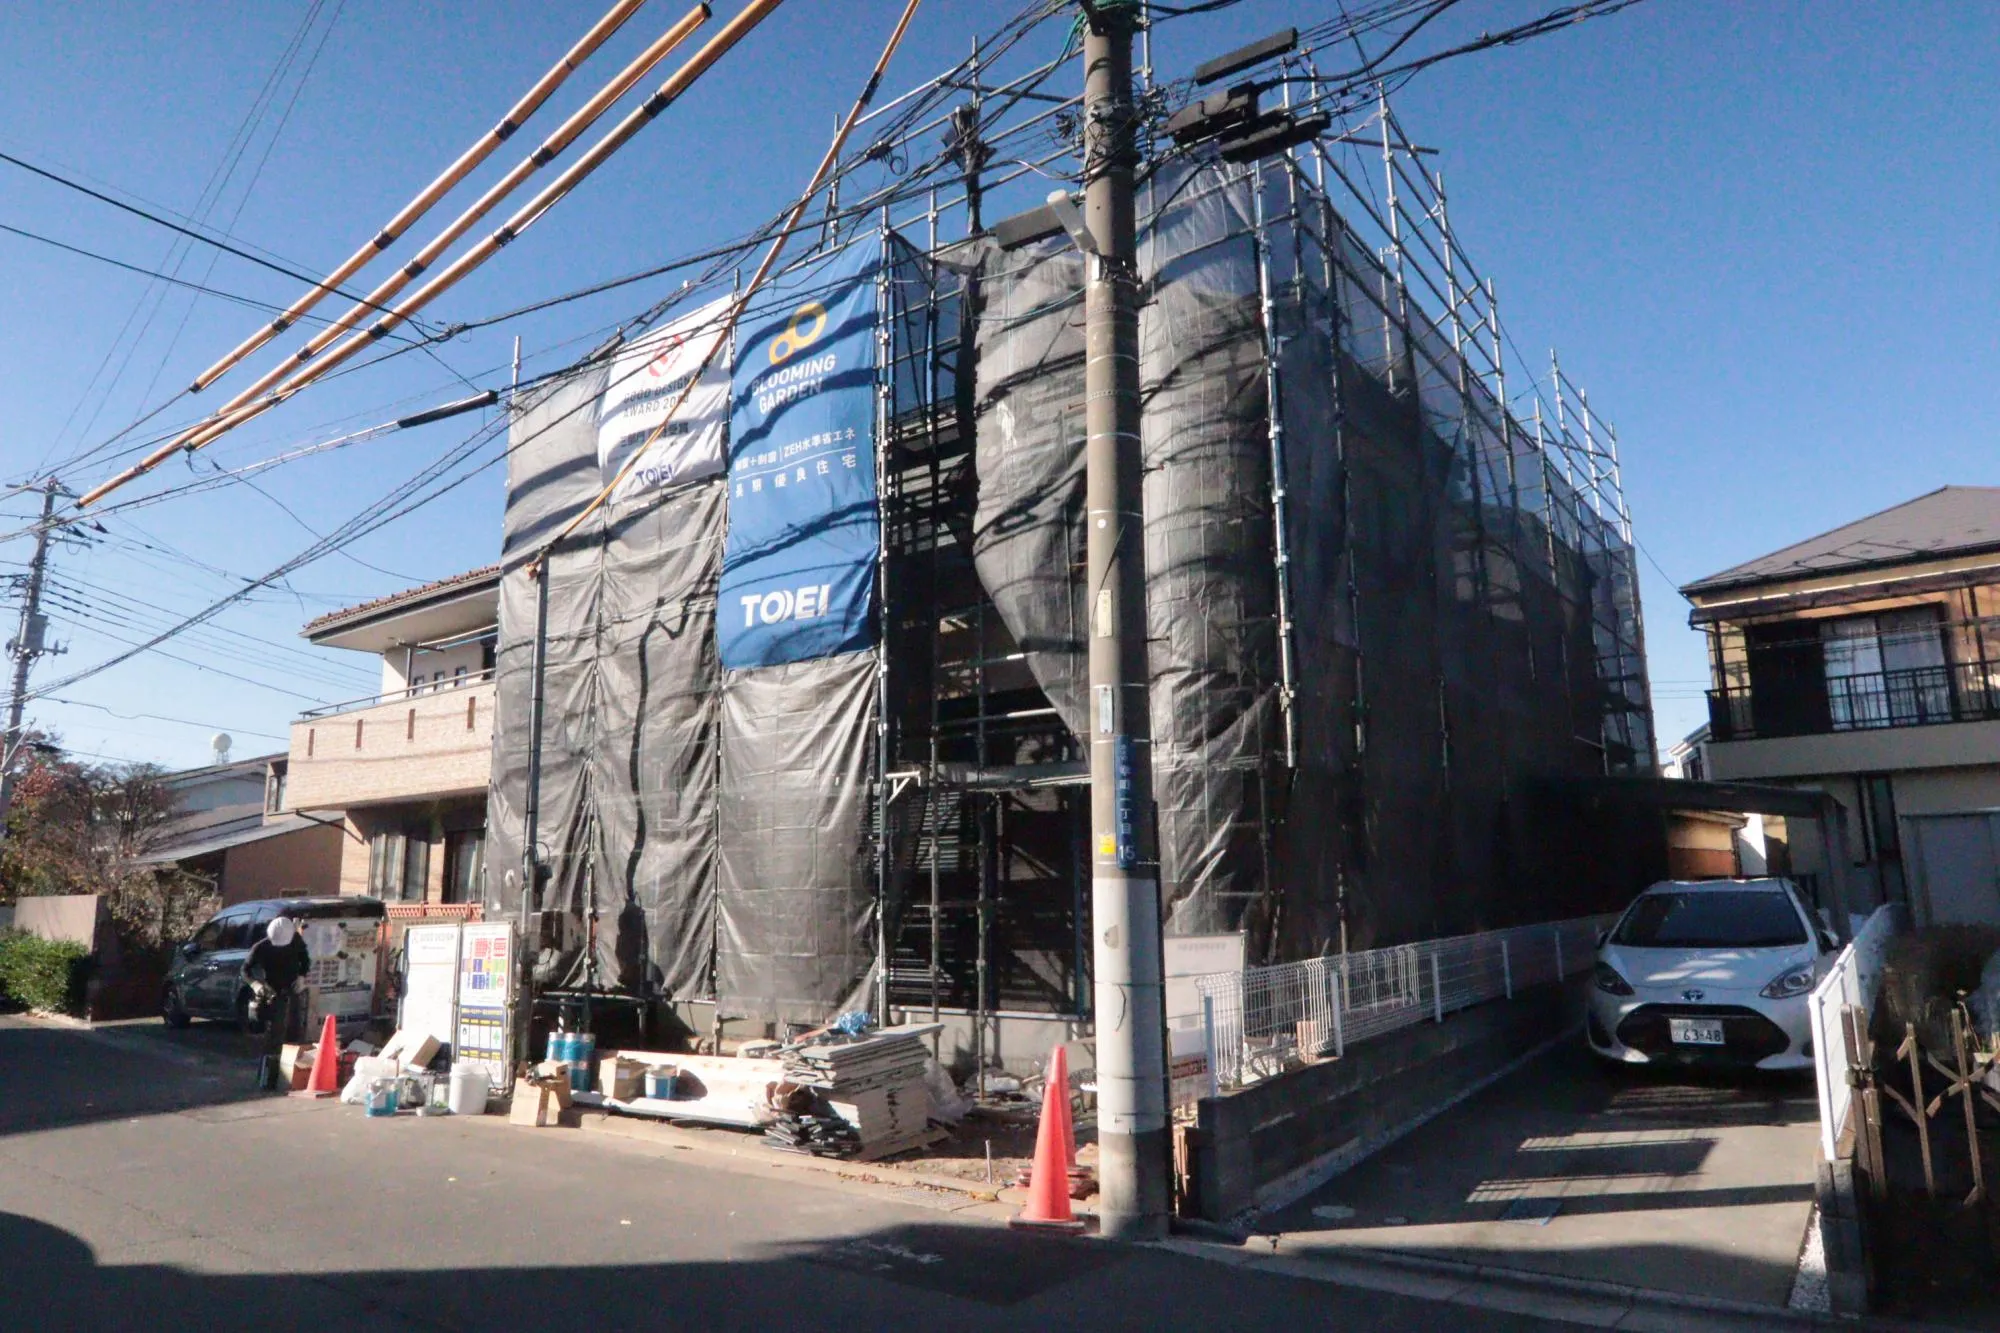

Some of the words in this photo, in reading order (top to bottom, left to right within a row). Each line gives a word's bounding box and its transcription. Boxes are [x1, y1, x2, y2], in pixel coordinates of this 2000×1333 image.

[752, 353, 836, 396] BLOOMING
[624, 387, 651, 404] GOOD
[624, 399, 660, 417] AWARD
[663, 393, 689, 409] 20
[759, 376, 823, 415] GARDEN
[635, 463, 673, 485] TOEI
[740, 584, 831, 627] TOEI
[1118, 844, 1137, 861] 15
